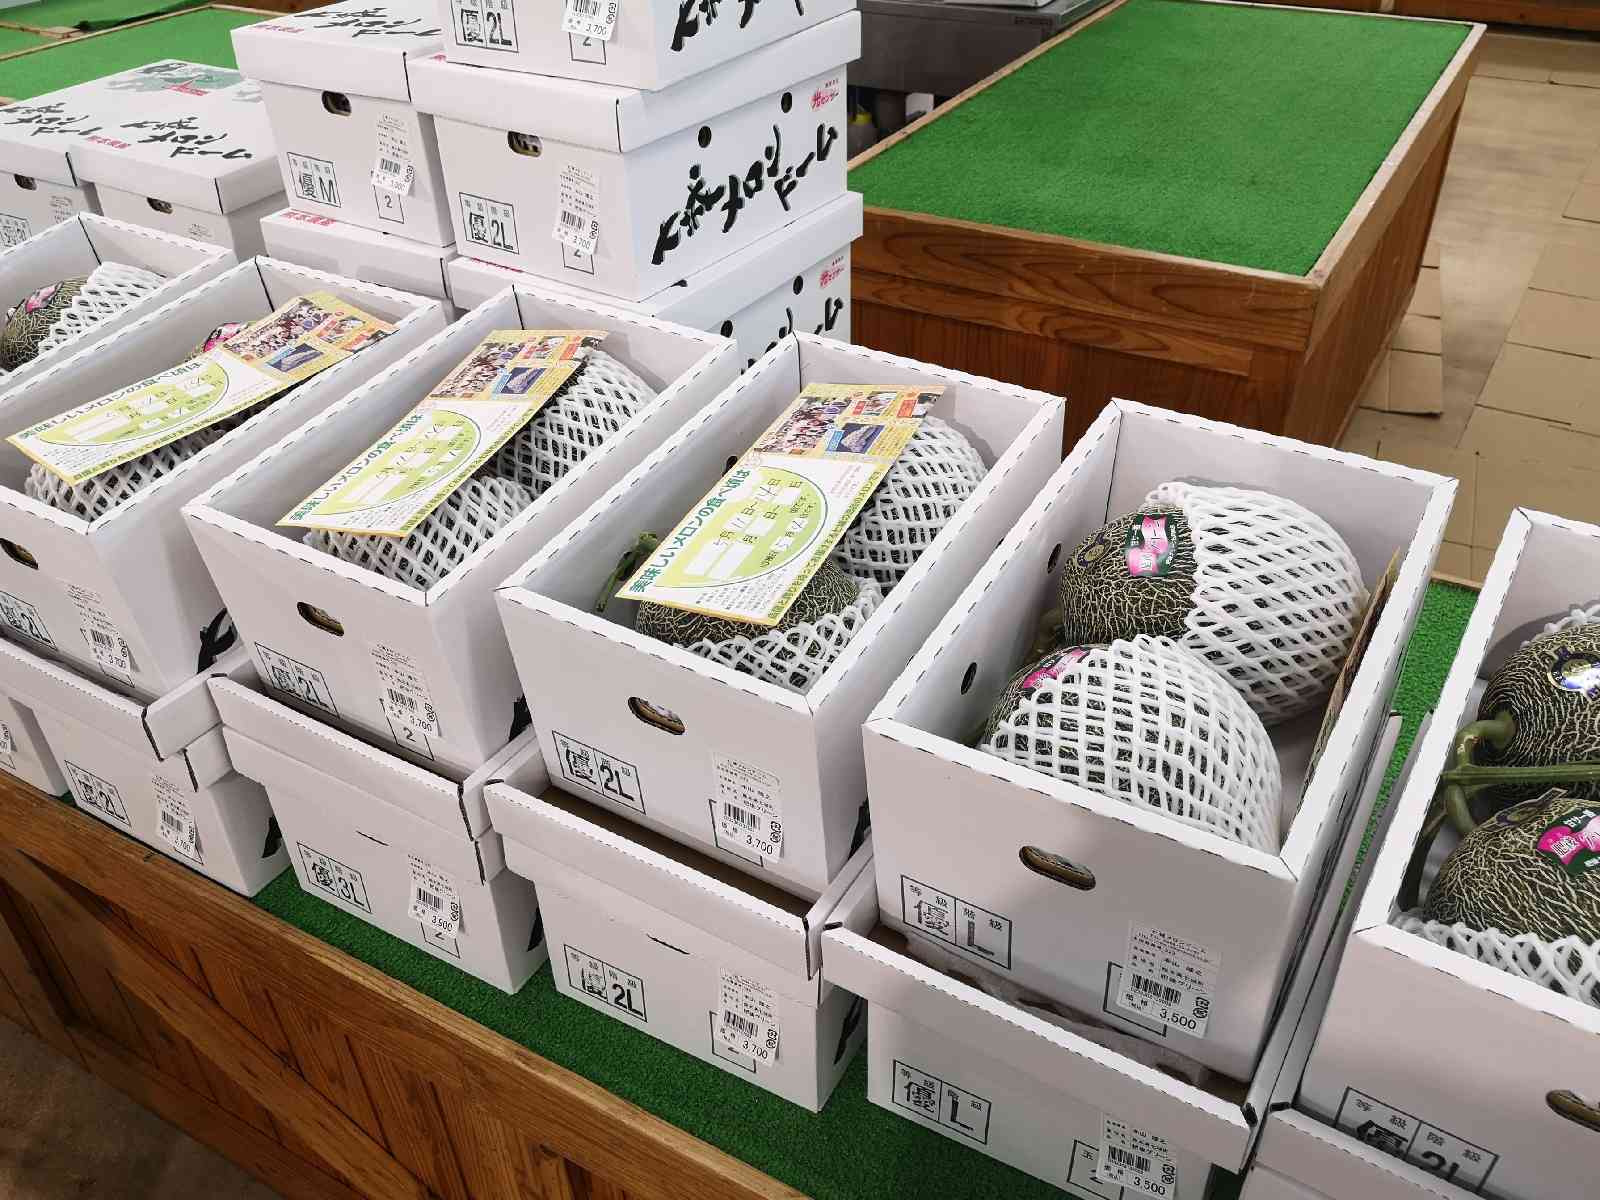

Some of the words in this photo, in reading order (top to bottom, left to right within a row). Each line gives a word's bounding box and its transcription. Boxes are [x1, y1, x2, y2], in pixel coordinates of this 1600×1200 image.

[486, 11, 513, 46] 2L
[319, 176, 337, 204] M
[490, 219, 514, 251] 2L
[629, 468, 751, 594] 美味しいメロンの食べ頃は
[297, 675, 331, 709] 2L
[403, 727, 416, 743] 2
[600, 765, 634, 801] 2L
[99, 790, 125, 820] 2L
[746, 834, 773, 854] 3,700
[337, 877, 365, 907] 3L
[914, 900, 949, 935] 優
[967, 920, 995, 956] L
[611, 983, 644, 1017] 2L
[1160, 1008, 1197, 1030] 3,500
[904, 1081, 936, 1113] 優
[950, 1100, 975, 1131] L
